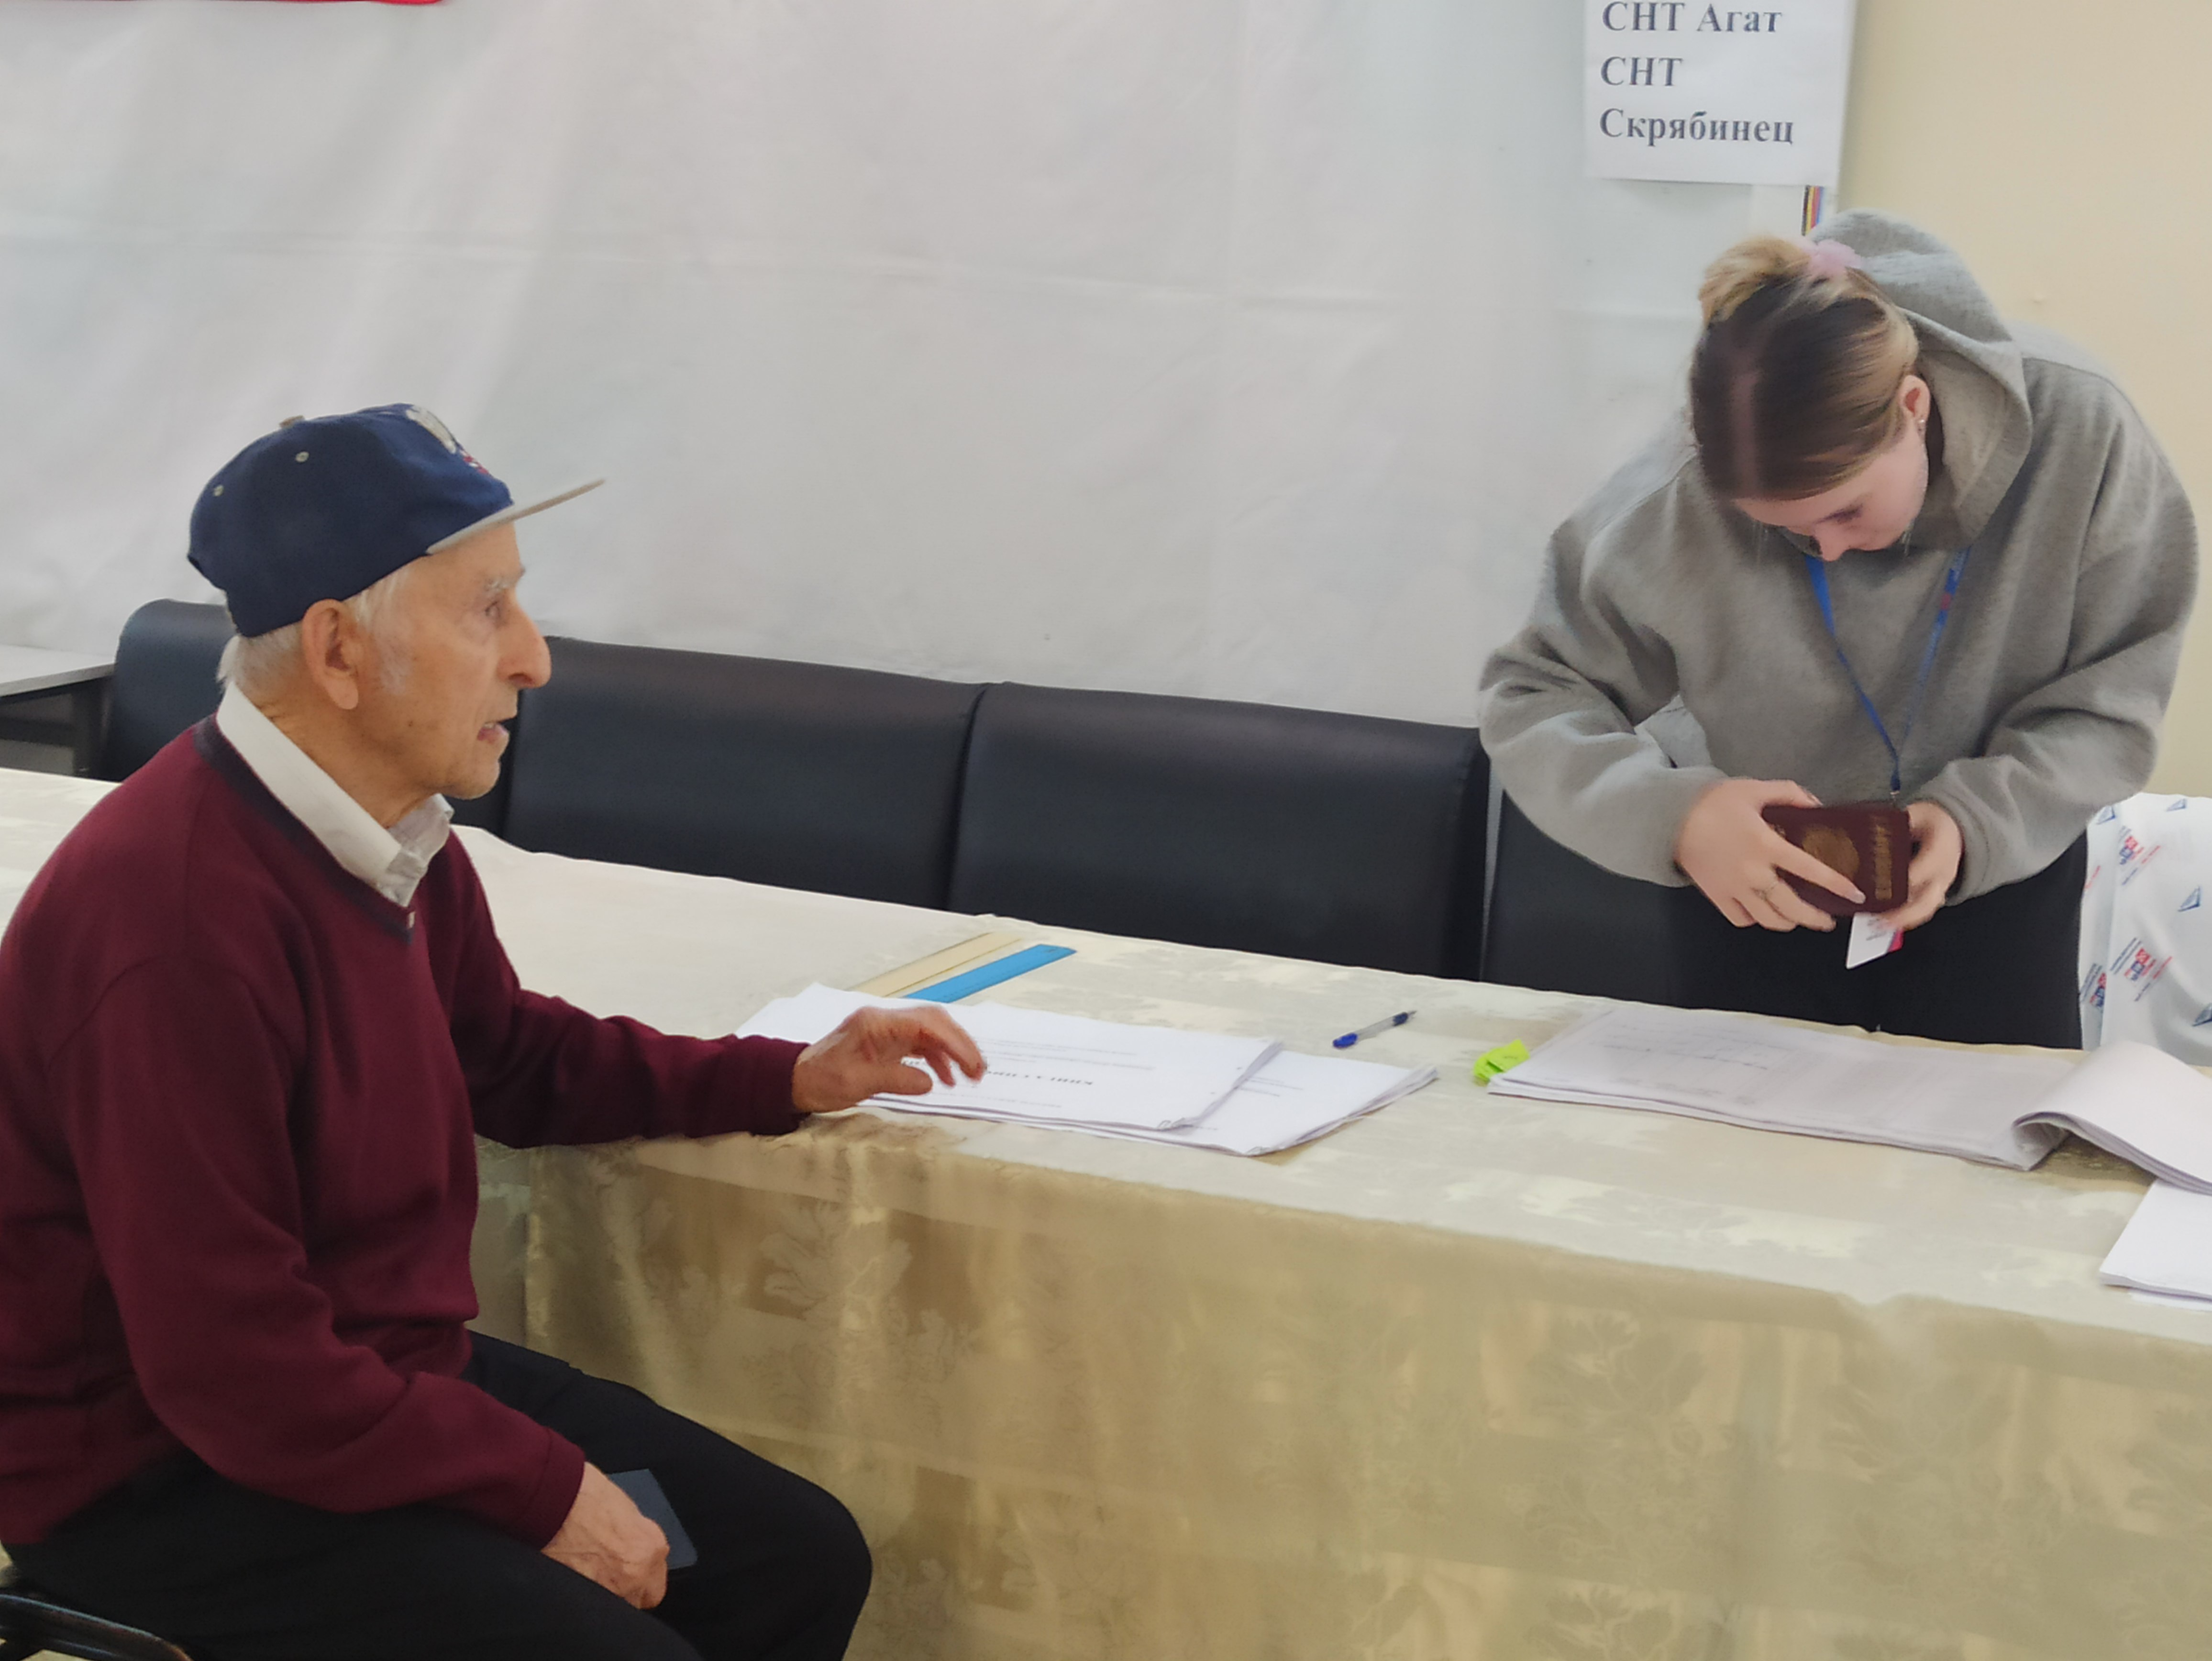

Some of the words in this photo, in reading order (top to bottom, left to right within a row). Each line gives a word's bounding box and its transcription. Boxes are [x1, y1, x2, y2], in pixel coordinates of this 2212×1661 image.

[1602, 1, 1686, 32] СНТ
[1696, 3, 1783, 33] Агат
[1600, 56, 1684, 87] СНТ
[1599, 108, 1794, 147] Скрябинец
